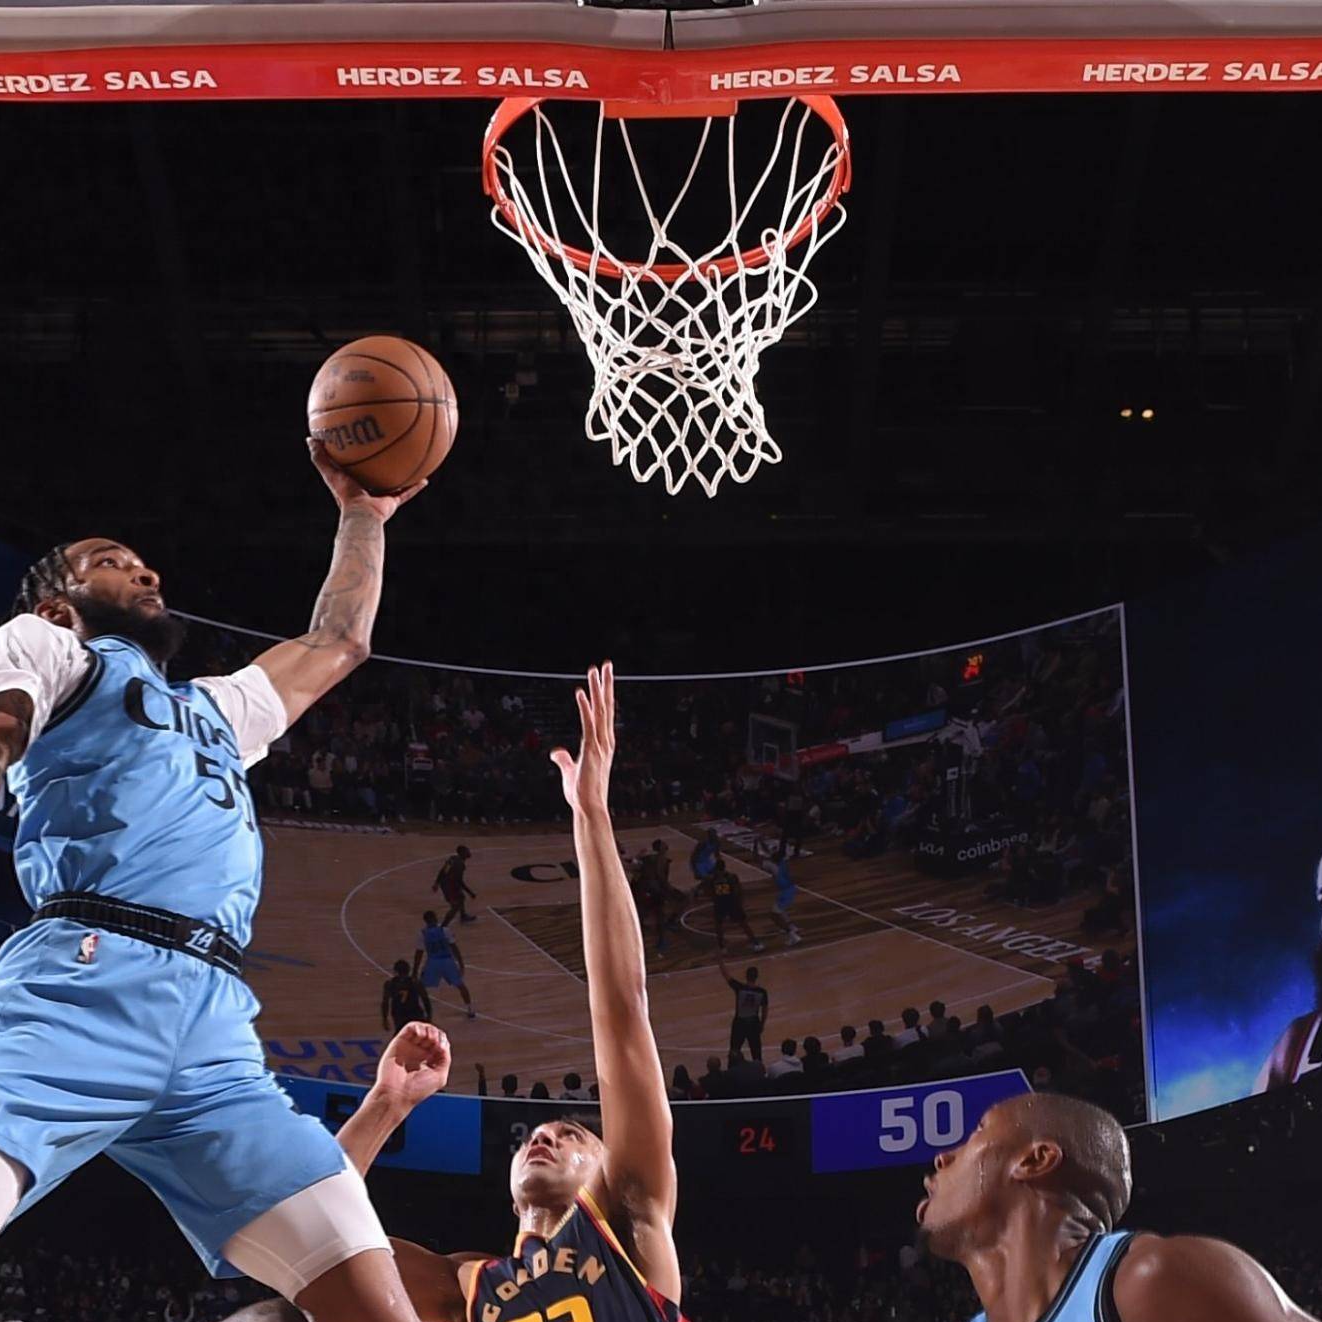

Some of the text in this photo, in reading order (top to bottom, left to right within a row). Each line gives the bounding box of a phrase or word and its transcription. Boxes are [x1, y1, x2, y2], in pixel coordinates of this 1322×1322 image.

[104, 69, 217, 90] SALSA
[337, 66, 589, 89] HERDEZ SALSA
[710, 64, 961, 90] HERDEZ SALSA
[1083, 63, 1208, 84] HERDEZ
[879, 1090, 965, 1152] 50
[739, 1127, 776, 1154] 24
